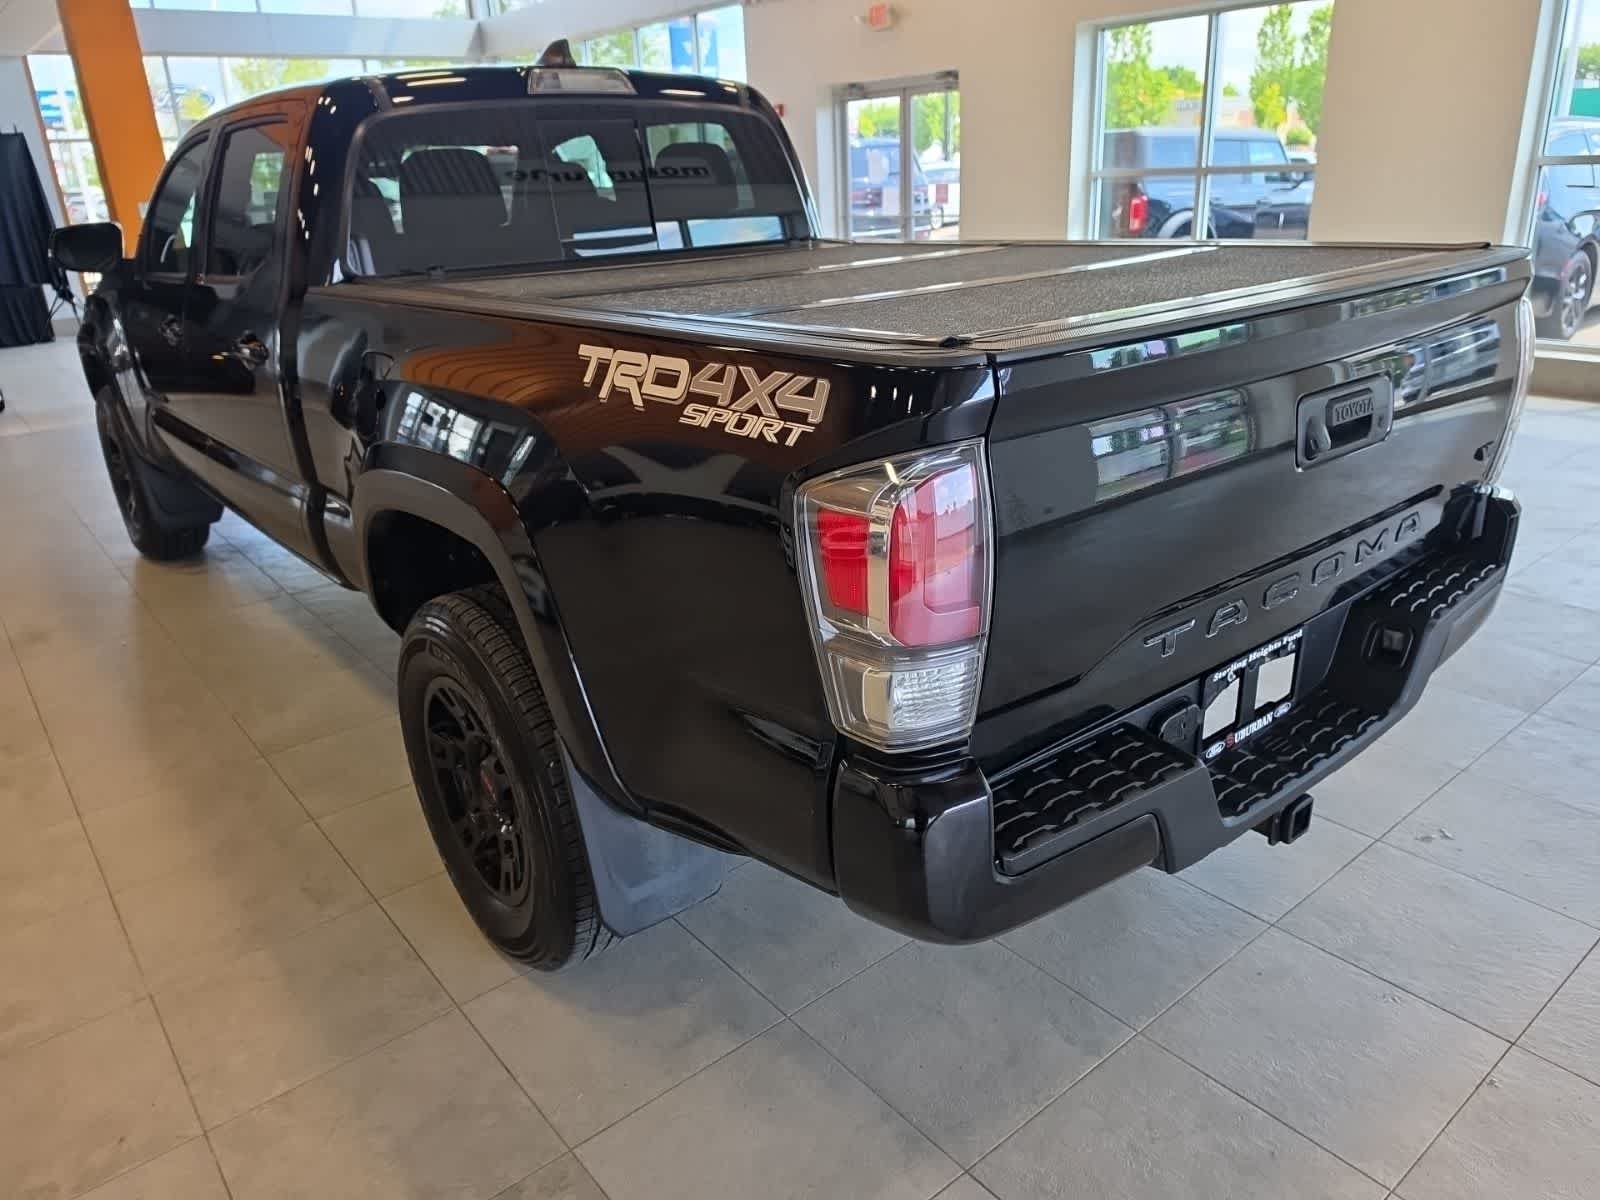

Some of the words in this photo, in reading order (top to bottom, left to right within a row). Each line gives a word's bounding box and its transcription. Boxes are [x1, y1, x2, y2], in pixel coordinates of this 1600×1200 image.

[578, 344, 692, 412] TRD
[678, 403, 815, 447] SPORT
[1335, 397, 1374, 422] TOYOTA
[1143, 511, 1421, 658] TACOMA
[1212, 658, 1248, 682] Sterling
[1248, 640, 1282, 662] Heights
[1282, 629, 1303, 645] Ford
[1226, 711, 1274, 748] SUBURBAN
